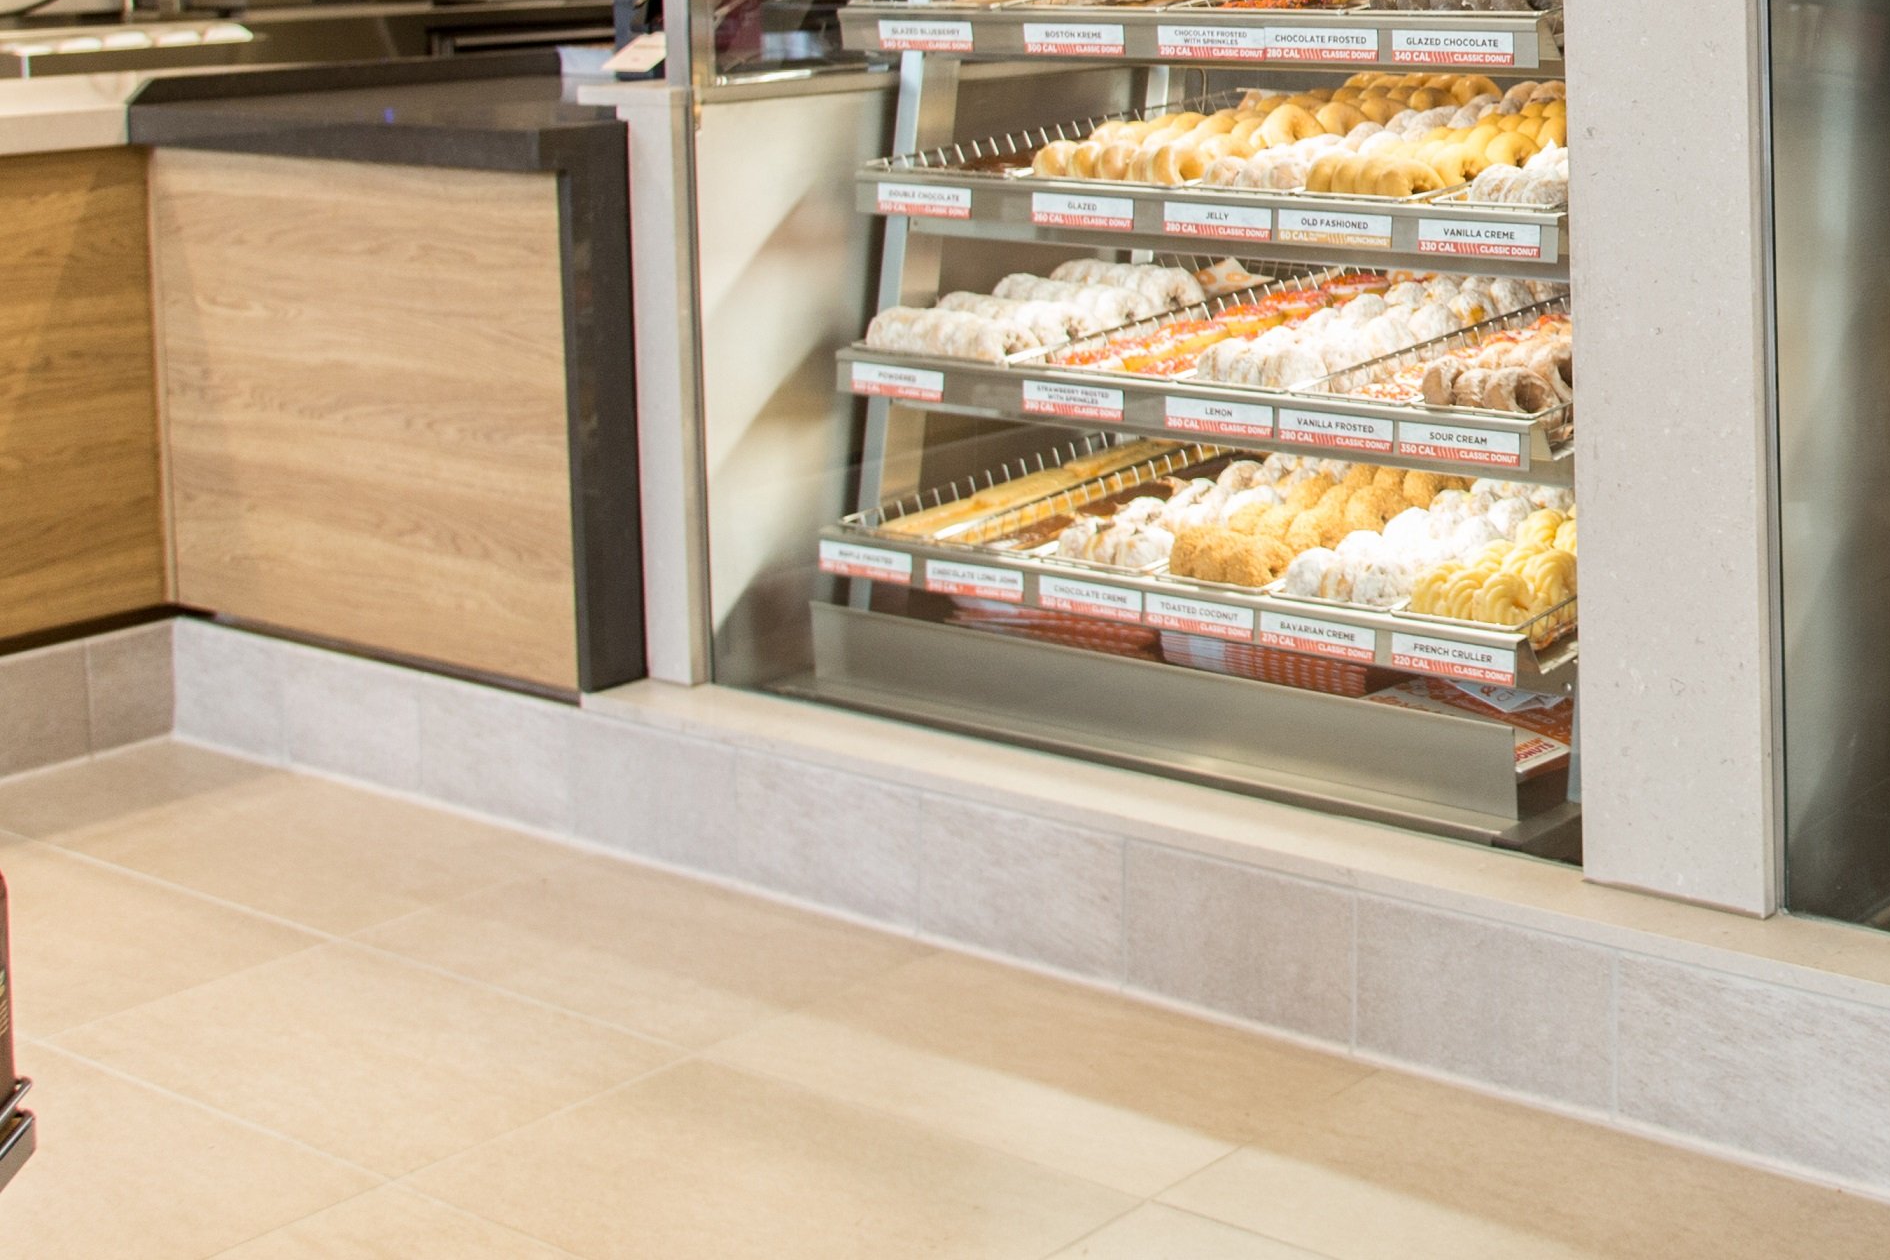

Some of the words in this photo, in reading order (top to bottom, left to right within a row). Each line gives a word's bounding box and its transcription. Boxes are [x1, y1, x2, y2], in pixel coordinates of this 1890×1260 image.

[1276, 35, 1326, 43] CHOCOLATE
[1328, 36, 1368, 44] FROSTED
[1406, 38, 1442, 46] GLAZED
[1444, 38, 1499, 47] CHOCOLATE
[1206, 212, 1230, 220] JELLY
[1301, 218, 1318, 226] OLD
[1320, 219, 1369, 229] FASHIONED
[1444, 229, 1483, 237] VANILLA
[1485, 230, 1516, 239] CREME
[1205, 408, 1233, 417] LEMON
[1297, 418, 1333, 429] VANILLA
[1336, 422, 1375, 433] FROSTED
[1430, 432, 1454, 441] SOUR
[1456, 434, 1488, 444] CREAM
[1280, 621, 1325, 635] BAVARIAN
[1327, 629, 1356, 641] CREME
[1414, 644, 1449, 657] FRENCH
[1452, 649, 1493, 662] CRULLER
